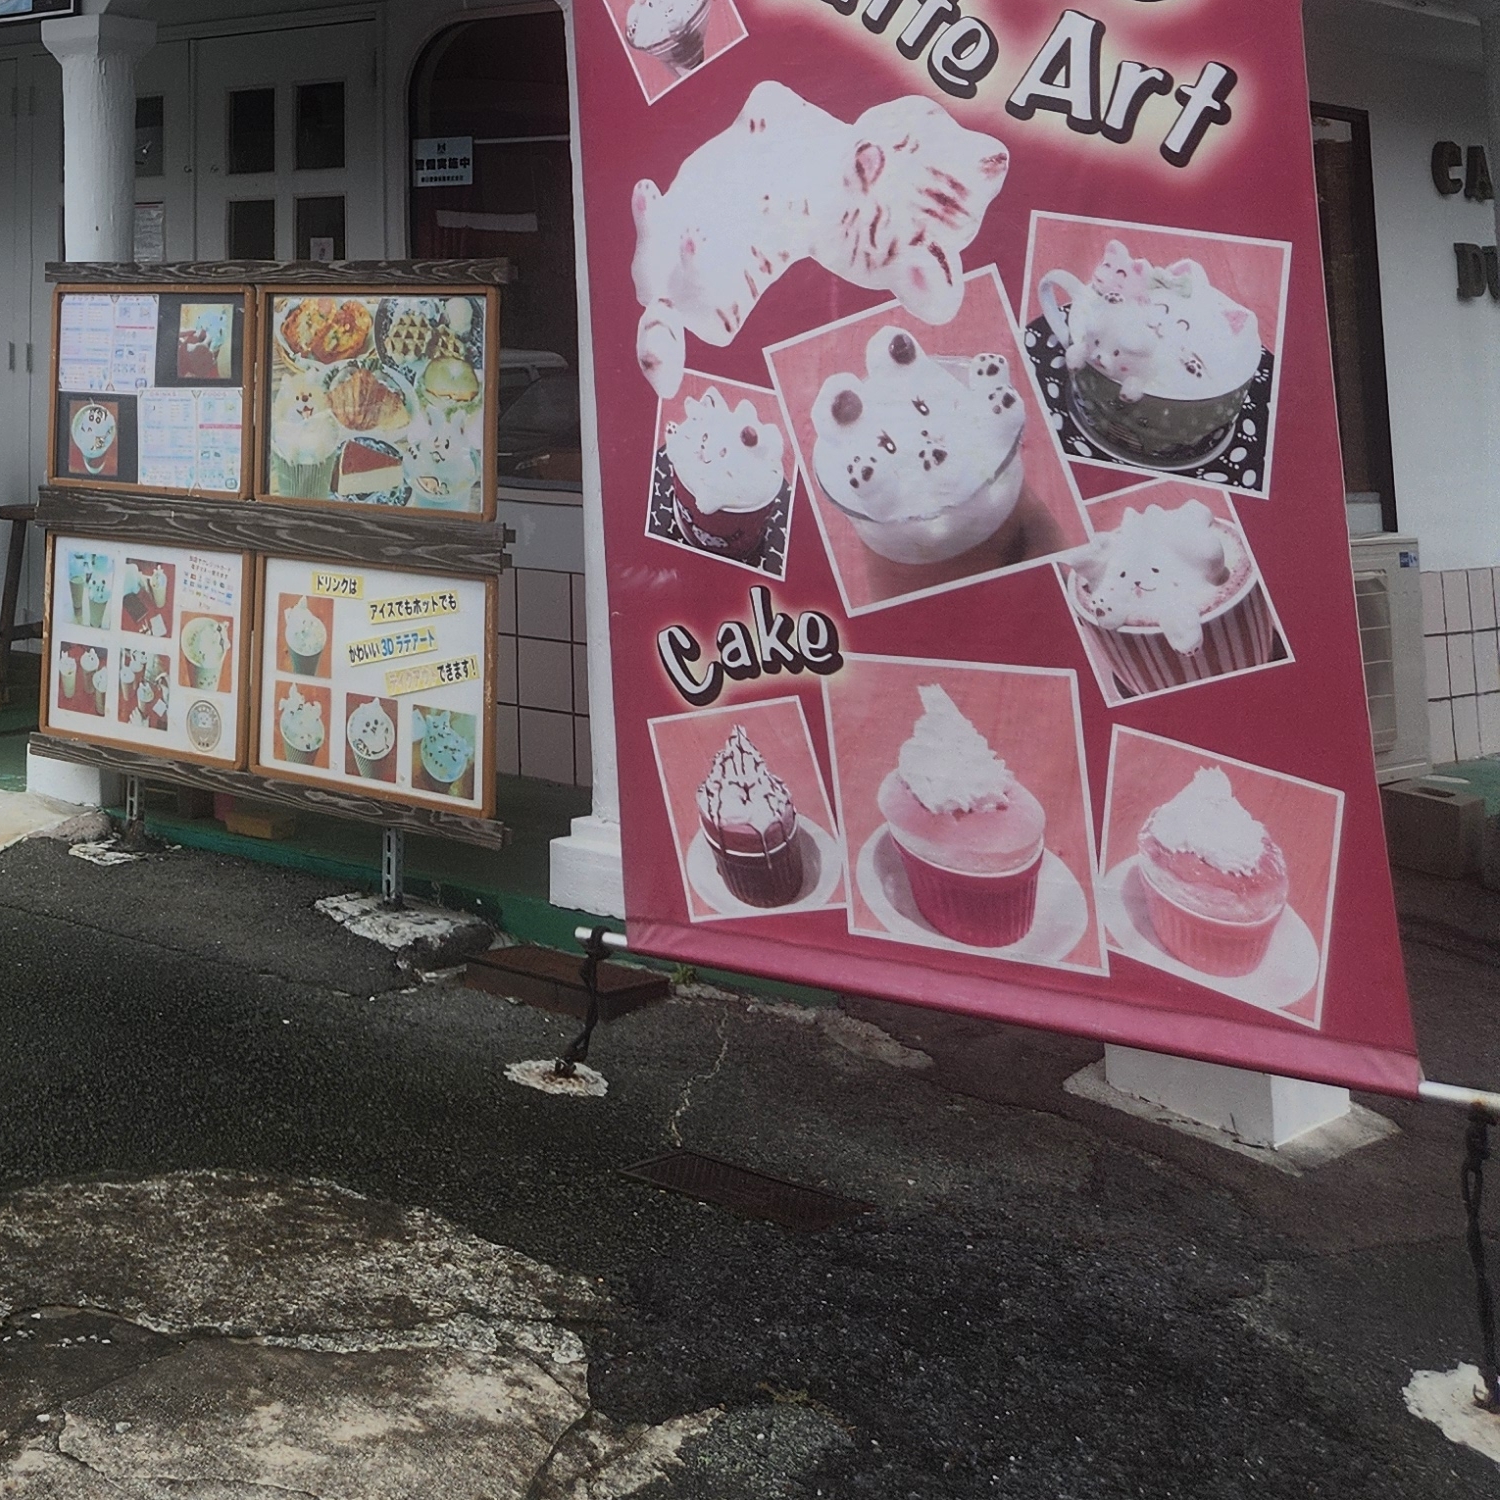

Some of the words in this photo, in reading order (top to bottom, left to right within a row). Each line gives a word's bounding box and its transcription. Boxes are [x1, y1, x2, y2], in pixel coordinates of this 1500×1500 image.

[1005, 10, 1238, 168] Art
[316, 574, 358, 595] ドリンクは
[369, 592, 458, 620] アイスでもホットでも
[657, 585, 844, 707] Cake
